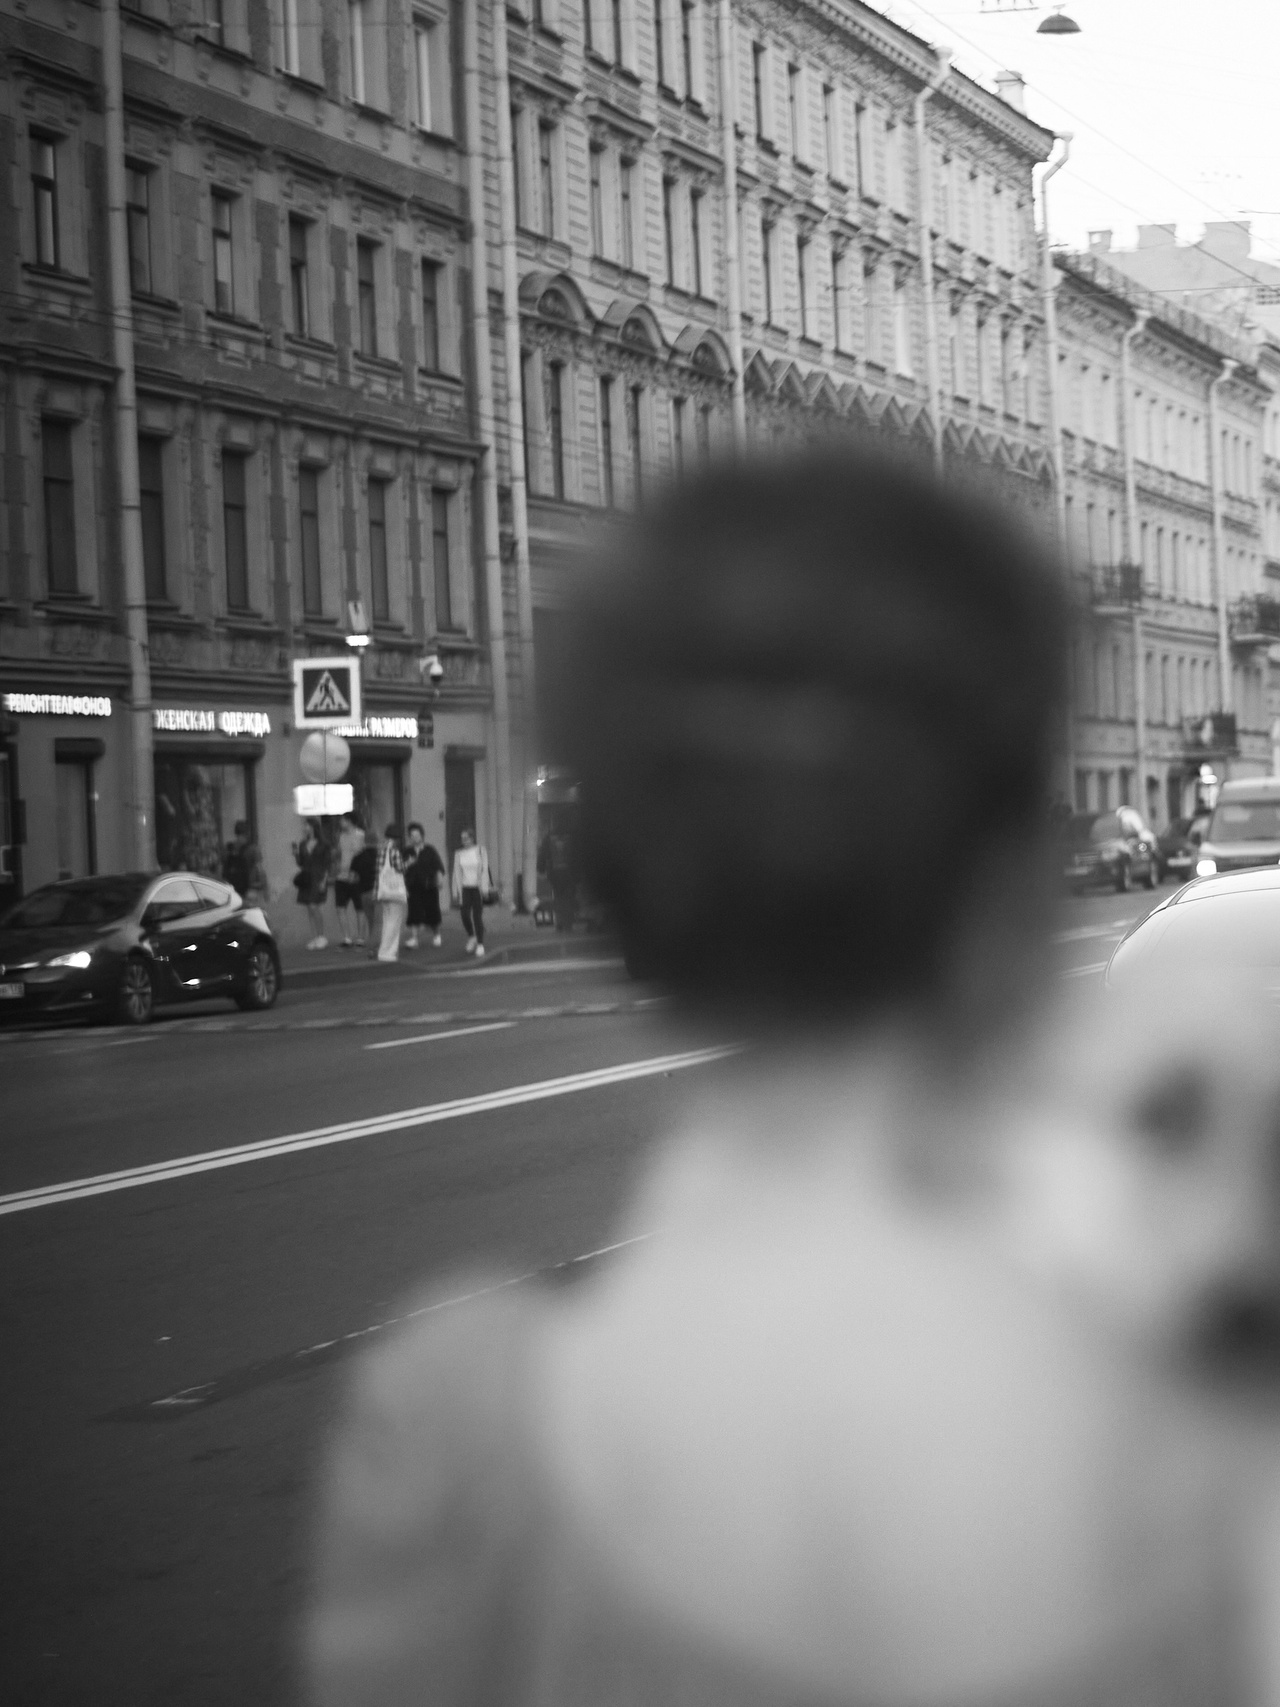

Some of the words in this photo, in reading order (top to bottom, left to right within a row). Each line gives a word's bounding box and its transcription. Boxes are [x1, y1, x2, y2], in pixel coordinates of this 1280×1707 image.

[6, 693, 50, 713] РЕМОНТ
[51, 694, 111, 717] ТЕЛЕФОНОВ
[155, 709, 215, 731] ЖЕНСКАЯ
[218, 711, 271, 738] ОДЕЖДА
[370, 717, 418, 738] РАЗМЕРОВ
